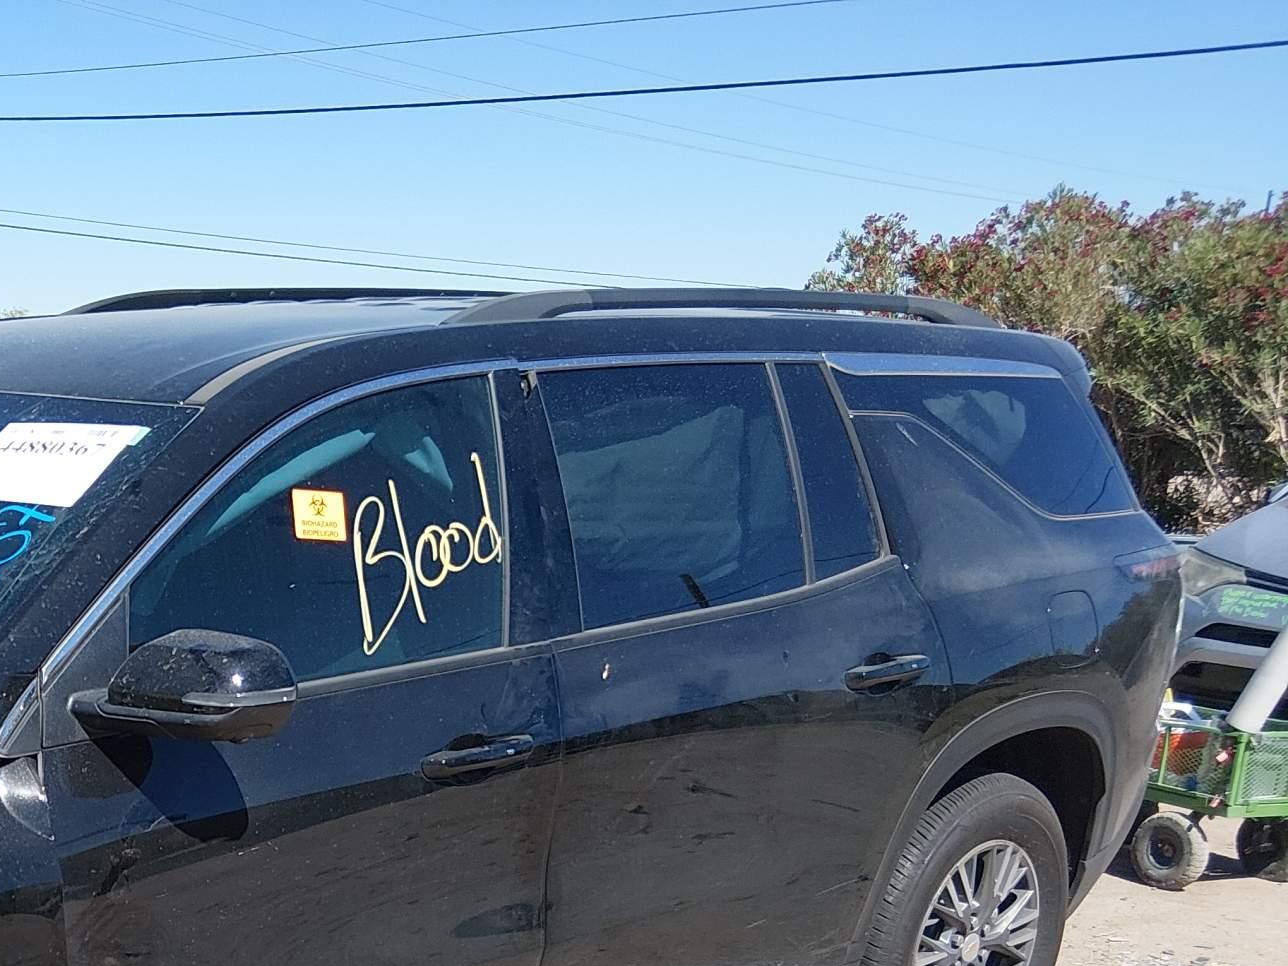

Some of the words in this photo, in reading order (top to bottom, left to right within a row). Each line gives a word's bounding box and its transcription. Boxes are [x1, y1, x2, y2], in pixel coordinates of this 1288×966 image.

[0, 440, 107, 457] 44880367
[302, 520, 338, 529] BIOHAZARD
[353, 451, 502, 656] Blood
